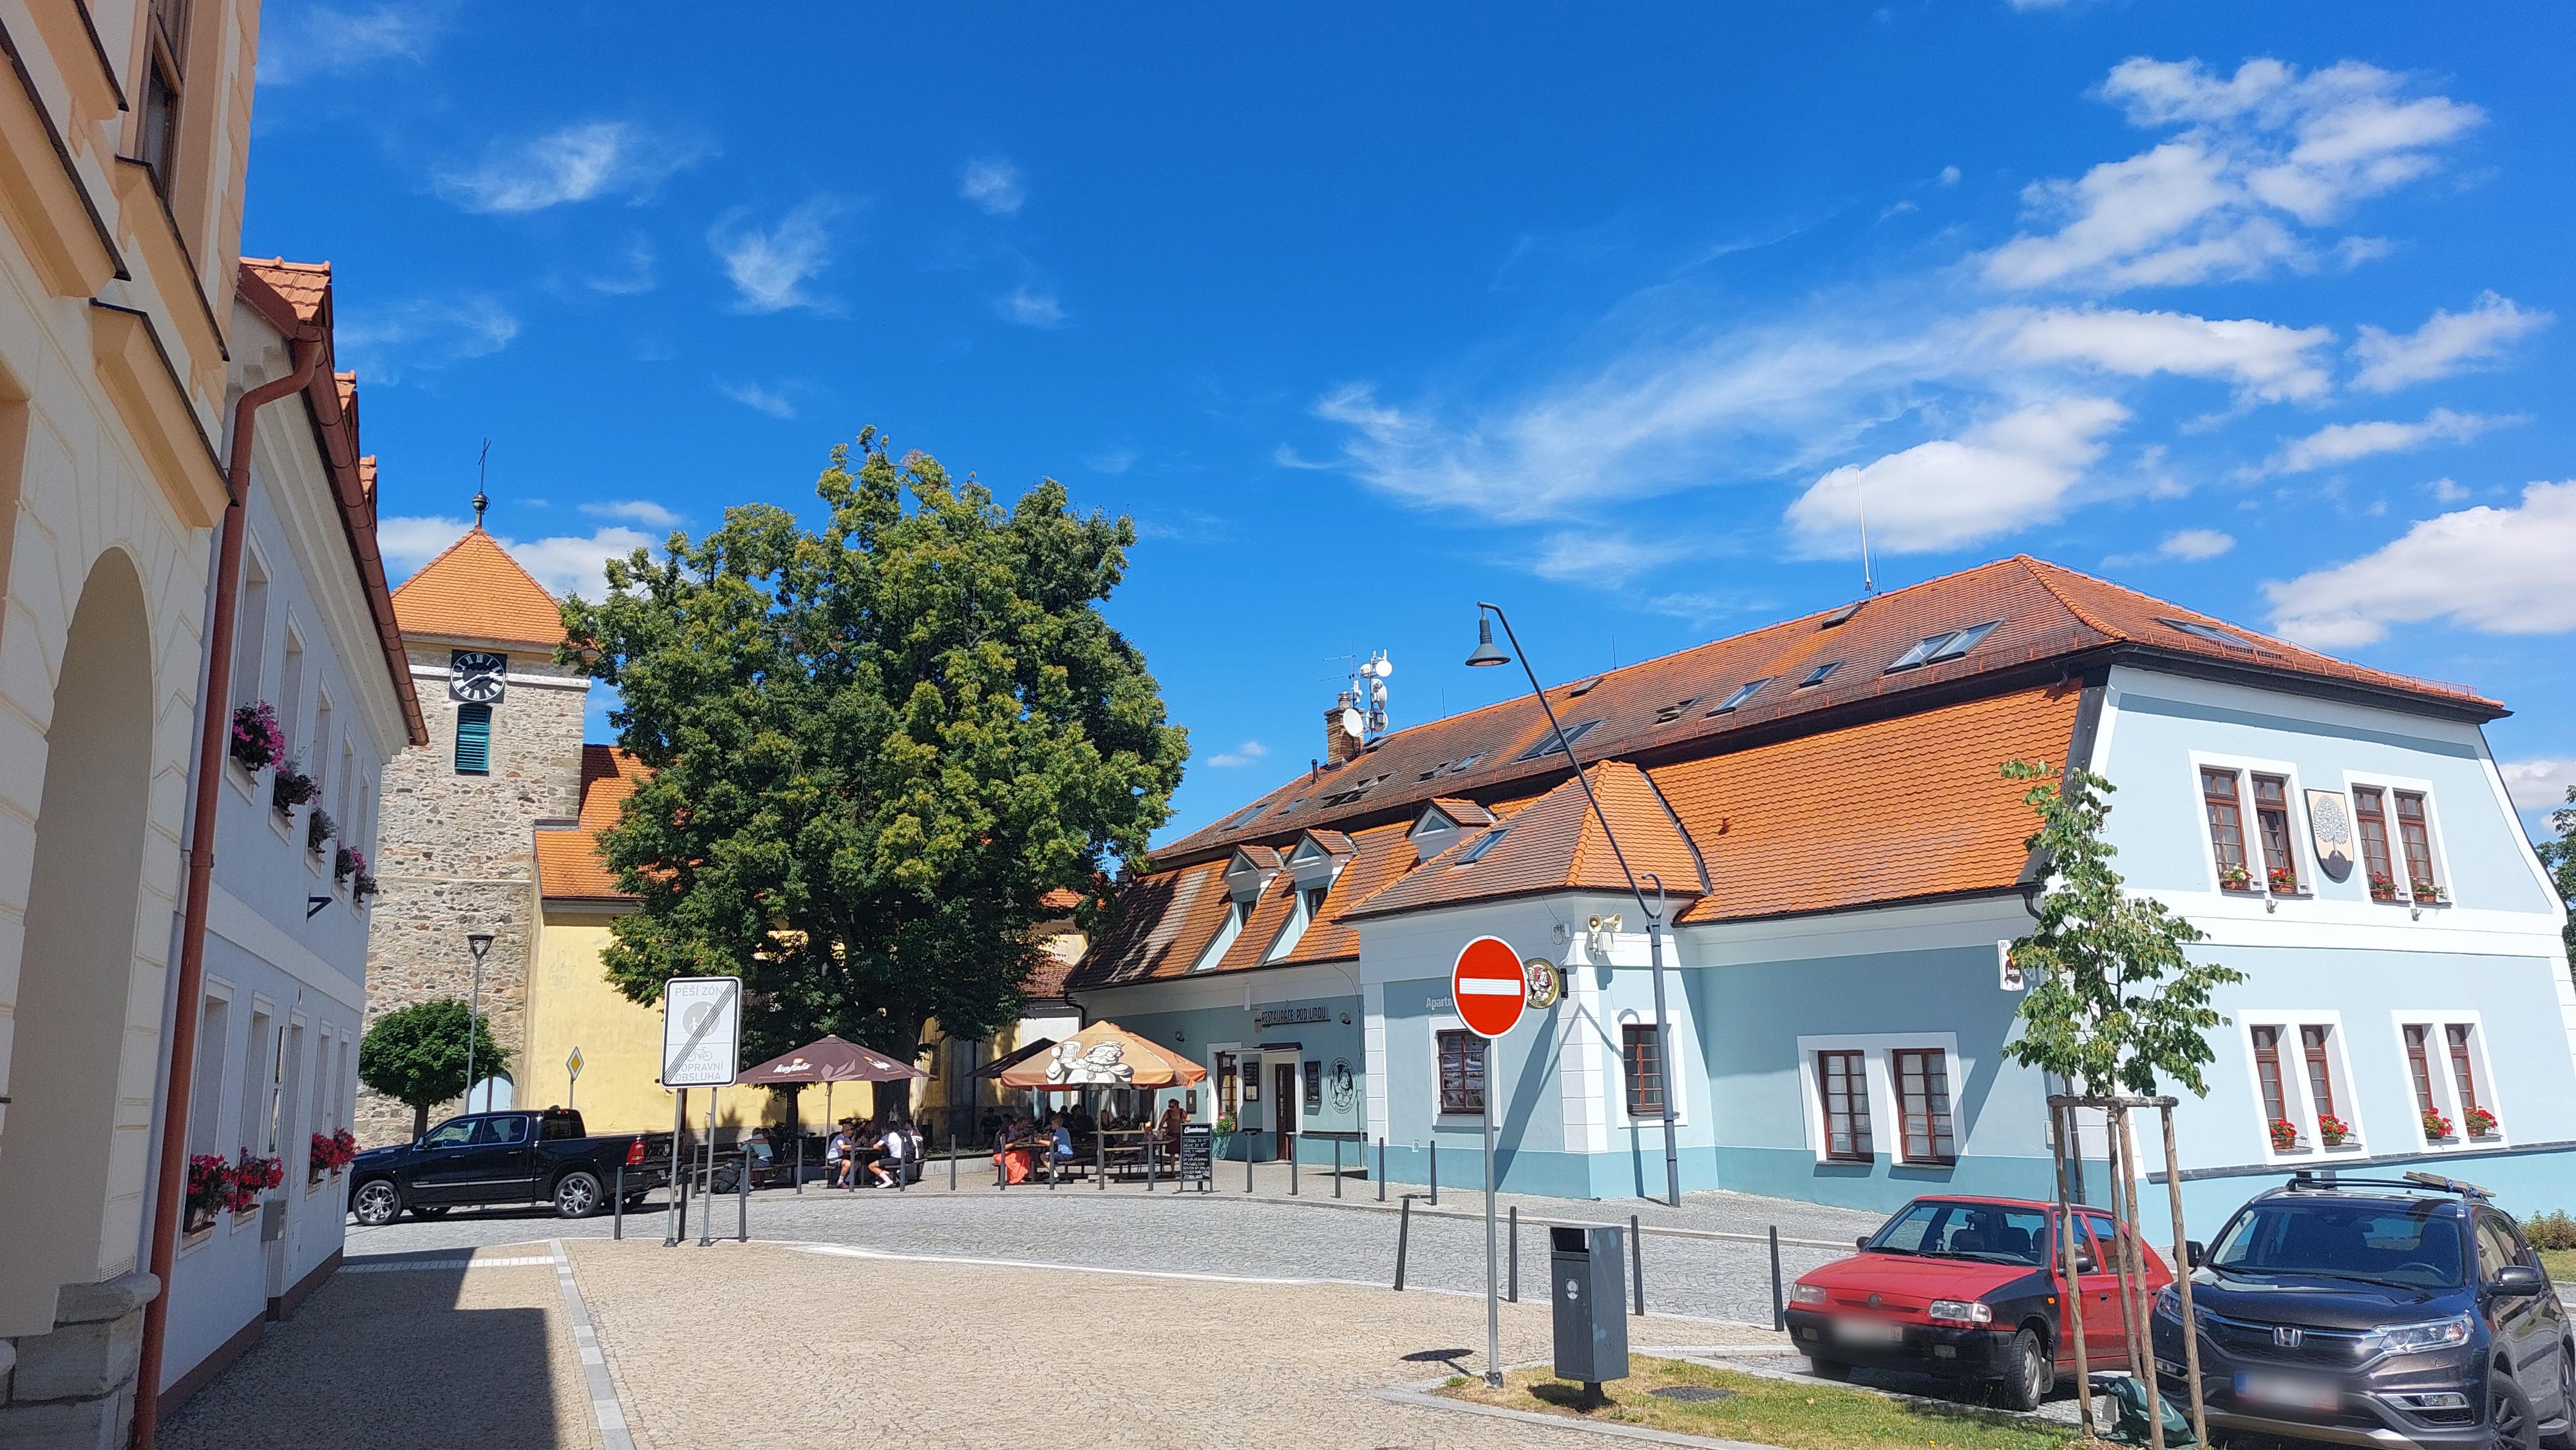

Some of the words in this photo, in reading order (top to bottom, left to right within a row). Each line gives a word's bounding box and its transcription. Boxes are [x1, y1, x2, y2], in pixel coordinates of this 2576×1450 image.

[675, 985, 699, 997] PĚŠÍ
[701, 984, 723, 996] ZÓN
[1261, 1009, 1294, 1023] RESTAURACE
[1296, 1008, 1307, 1021] POD
[1309, 1006, 1327, 1020] LIPOU
[681, 1060, 724, 1072] OPRAVNÍ
[675, 1071, 721, 1082] OBSLUHA
